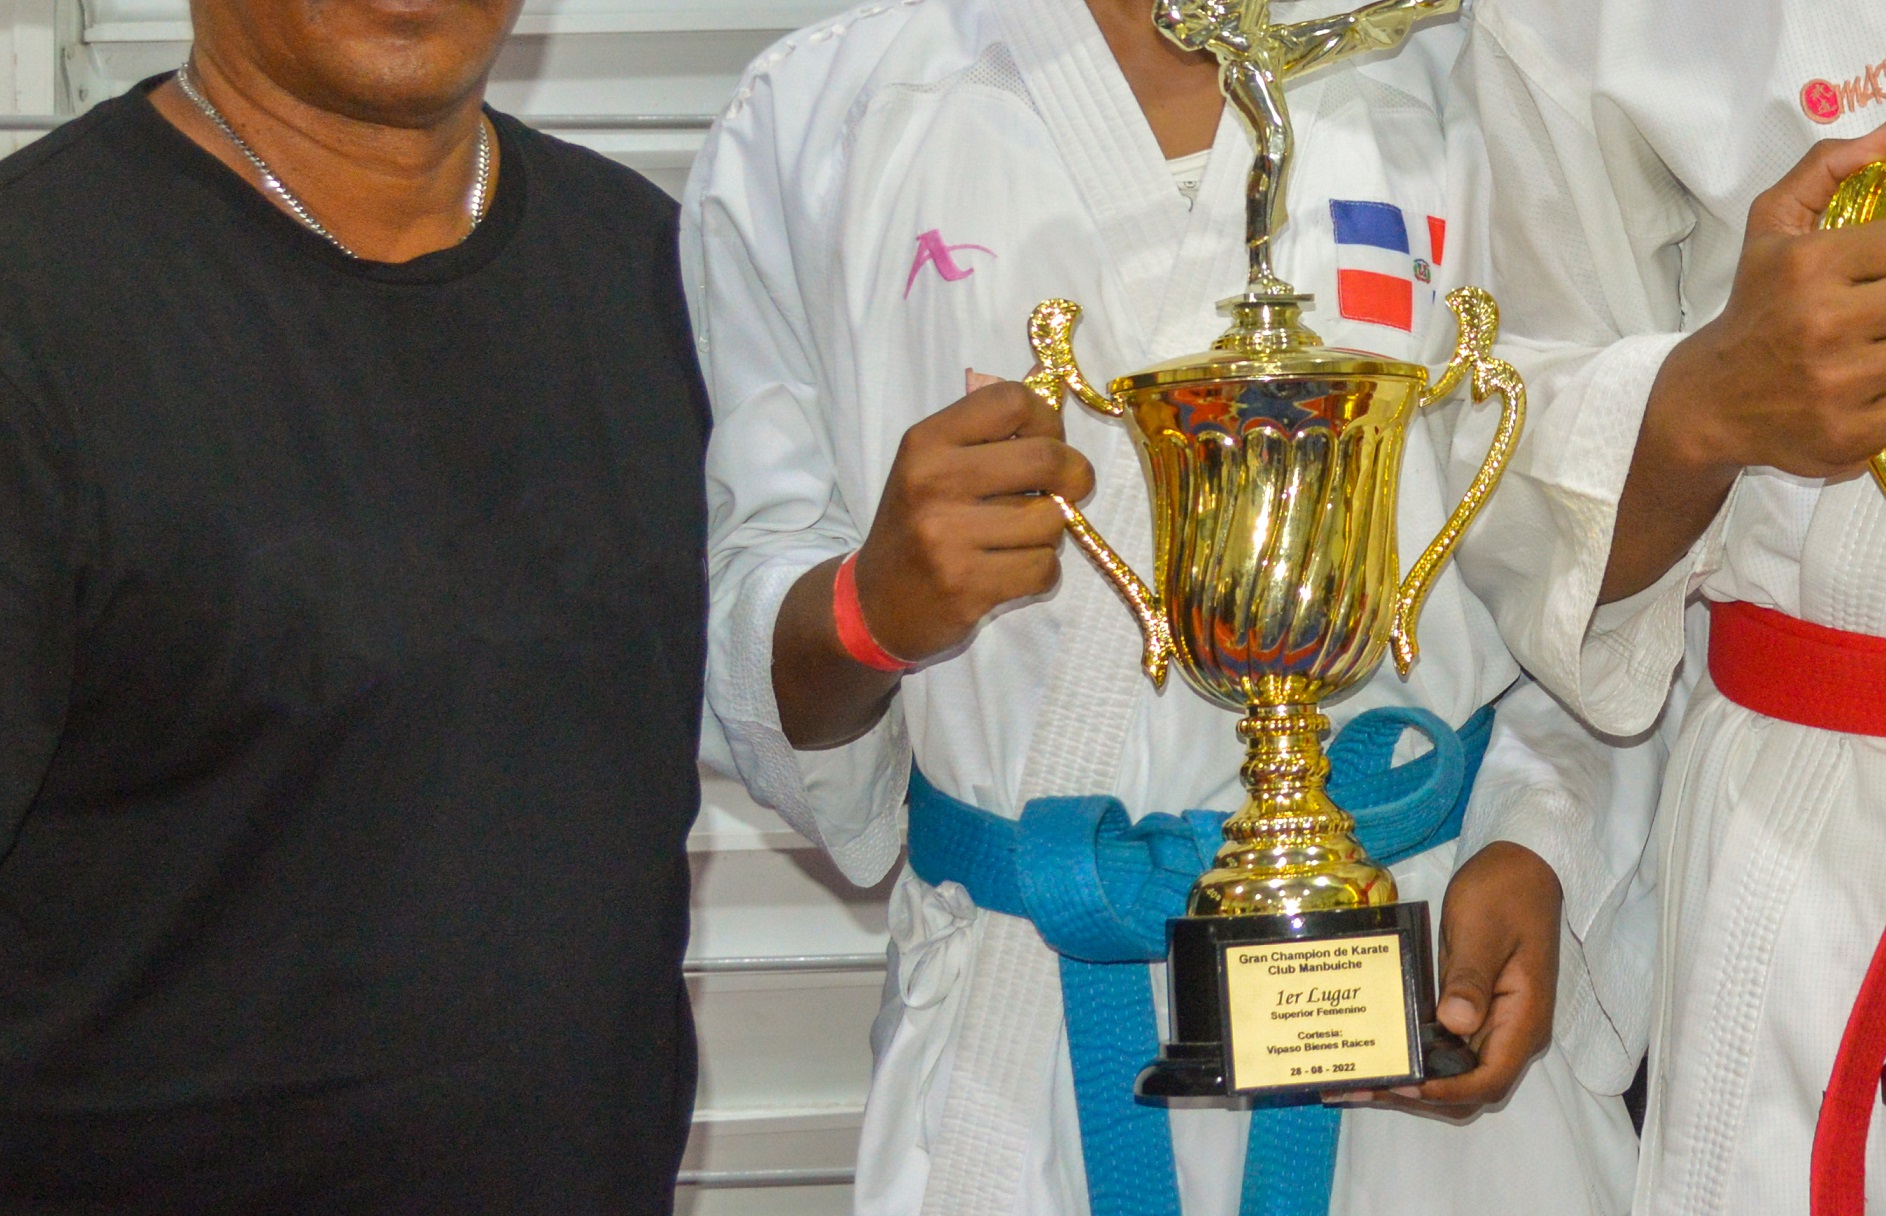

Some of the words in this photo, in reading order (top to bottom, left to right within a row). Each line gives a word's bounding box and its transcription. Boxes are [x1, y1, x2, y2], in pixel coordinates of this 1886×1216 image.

[1239, 953, 1268, 965] Gran
[1270, 948, 1331, 963] Champion
[1333, 946, 1348, 957] de
[1351, 944, 1389, 956] Karate
[1268, 964, 1296, 976] Club
[1299, 960, 1362, 974] Manbuiche
[1276, 989, 1304, 1007] 1er
[1306, 986, 1362, 1007] Lugar
[1270, 1009, 1314, 1021] Superior
[1316, 1005, 1367, 1017] Femenino
[1297, 1029, 1343, 1041] Cortesia:
[1267, 1043, 1302, 1056] Vipaso
[1304, 1041, 1339, 1052] Bienes
[1341, 1038, 1376, 1049] Raices
[1290, 1066, 1302, 1076] 28
[1311, 1065, 1323, 1075] 08
[1332, 1063, 1356, 1074] 2022
